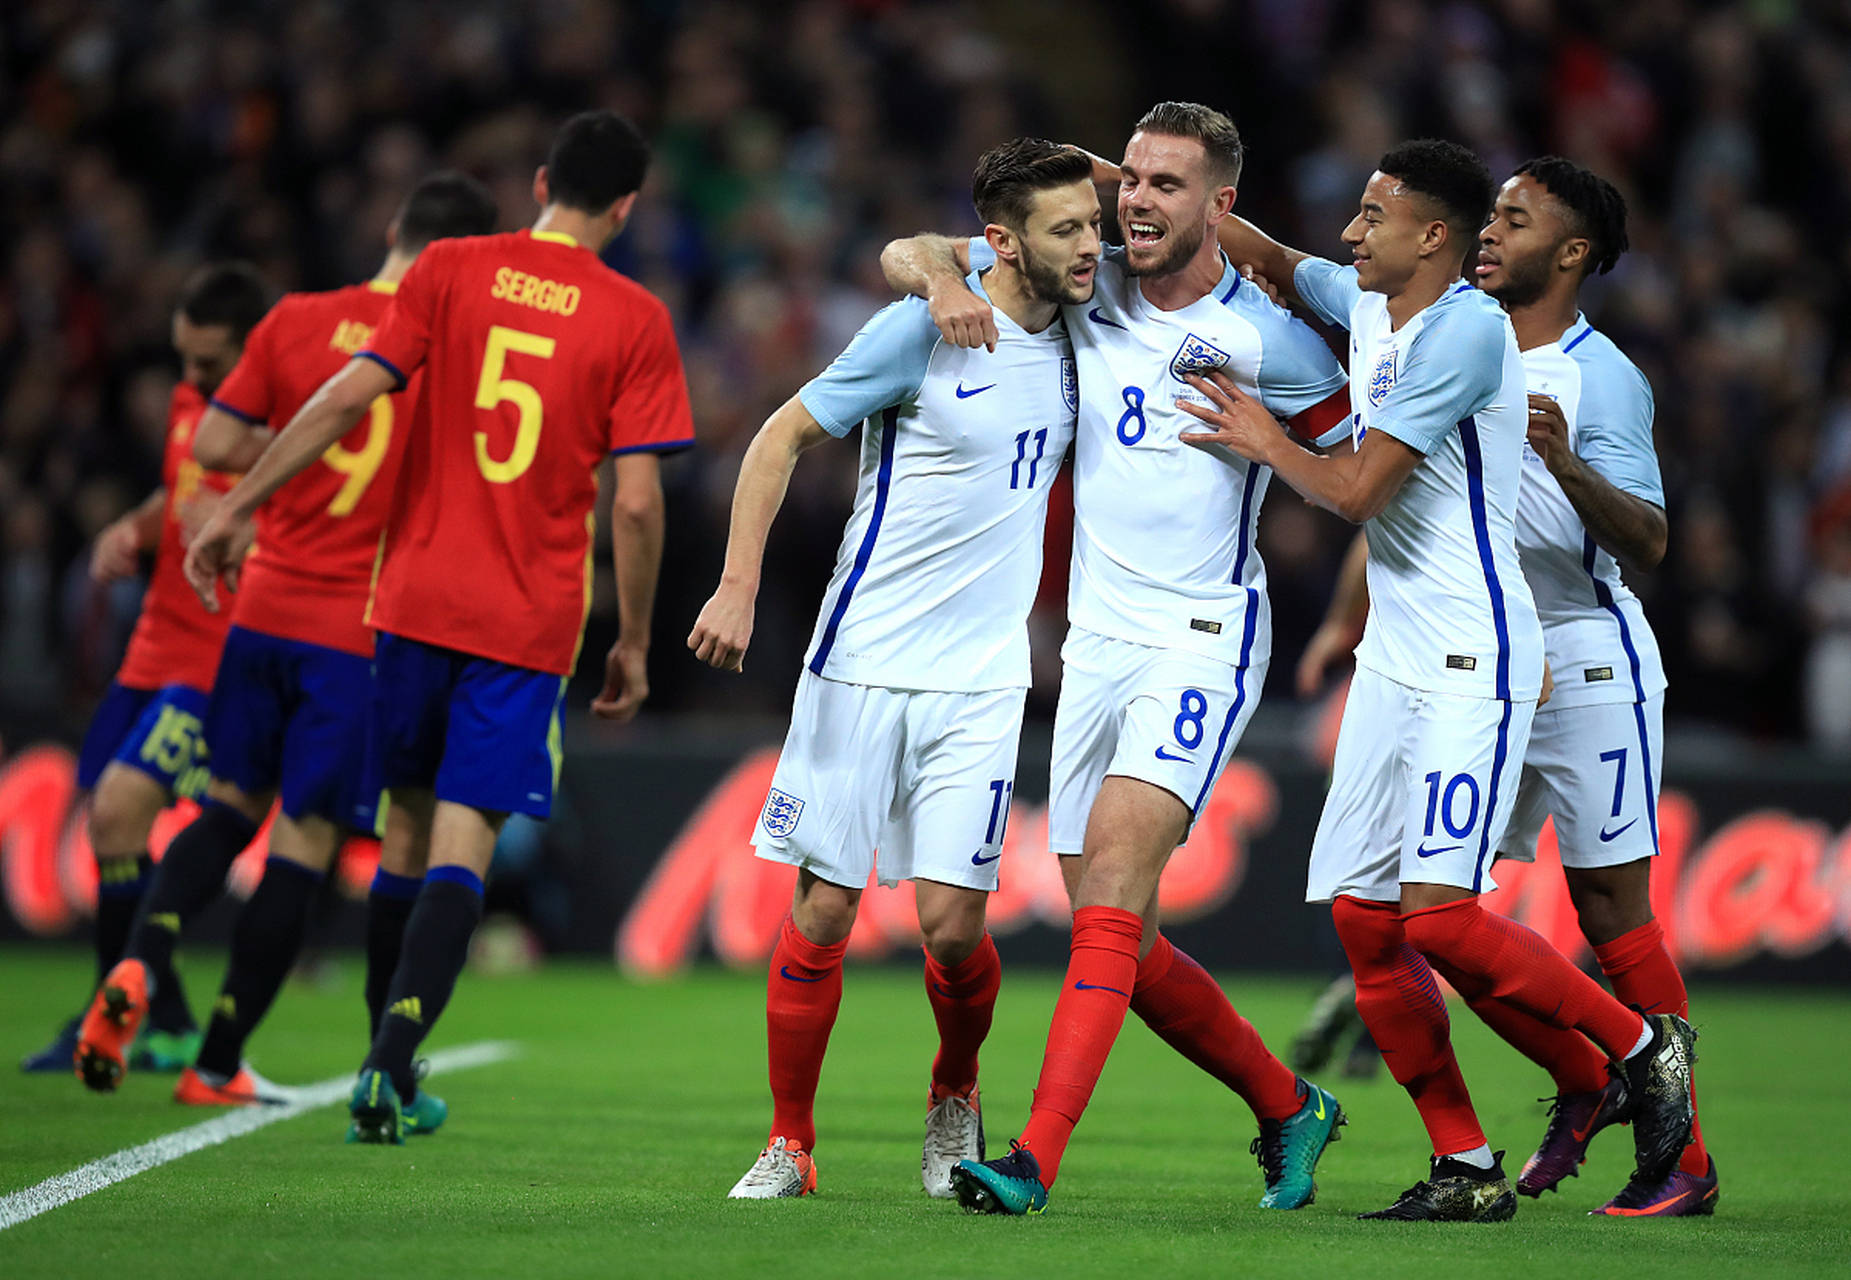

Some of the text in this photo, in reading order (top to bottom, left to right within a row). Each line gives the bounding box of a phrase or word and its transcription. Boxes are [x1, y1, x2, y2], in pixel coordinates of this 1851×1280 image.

[491, 266, 581, 317] SERGIO
[474, 324, 556, 484] 5
[1117, 386, 1146, 446] 8
[323, 392, 395, 516] 9
[1010, 427, 1048, 489] 11
[141, 704, 203, 774] 15
[1174, 689, 1207, 750] 8
[985, 779, 1012, 845] 11
[1423, 771, 1480, 839] 10
[1600, 748, 1627, 817] 7
